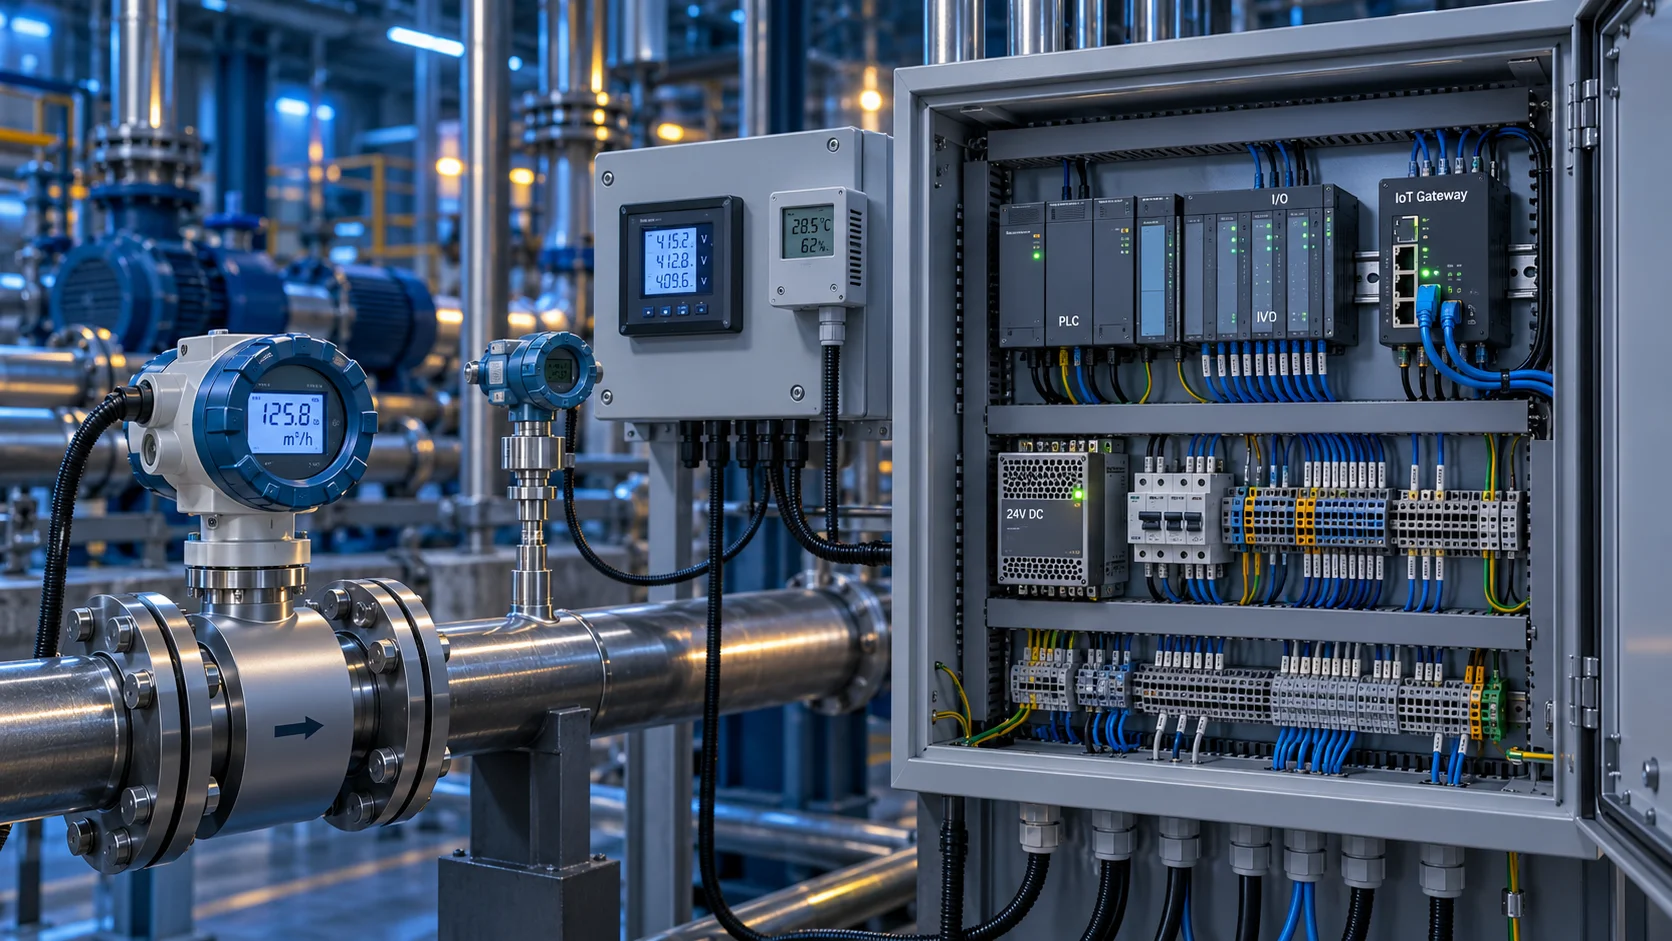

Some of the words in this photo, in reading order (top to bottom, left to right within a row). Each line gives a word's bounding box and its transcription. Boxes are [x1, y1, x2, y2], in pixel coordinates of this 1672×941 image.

[1271, 193, 1288, 206] I/O
[1395, 191, 1413, 204] IoT
[1416, 190, 1468, 203] Gateway
[700, 234, 708, 244] V
[700, 255, 708, 265] V
[700, 277, 708, 285] V
[1058, 315, 1080, 327] PLC
[263, 402, 311, 426] 125.8
[1006, 508, 1027, 520] 24V
[1029, 508, 1044, 520] DC
